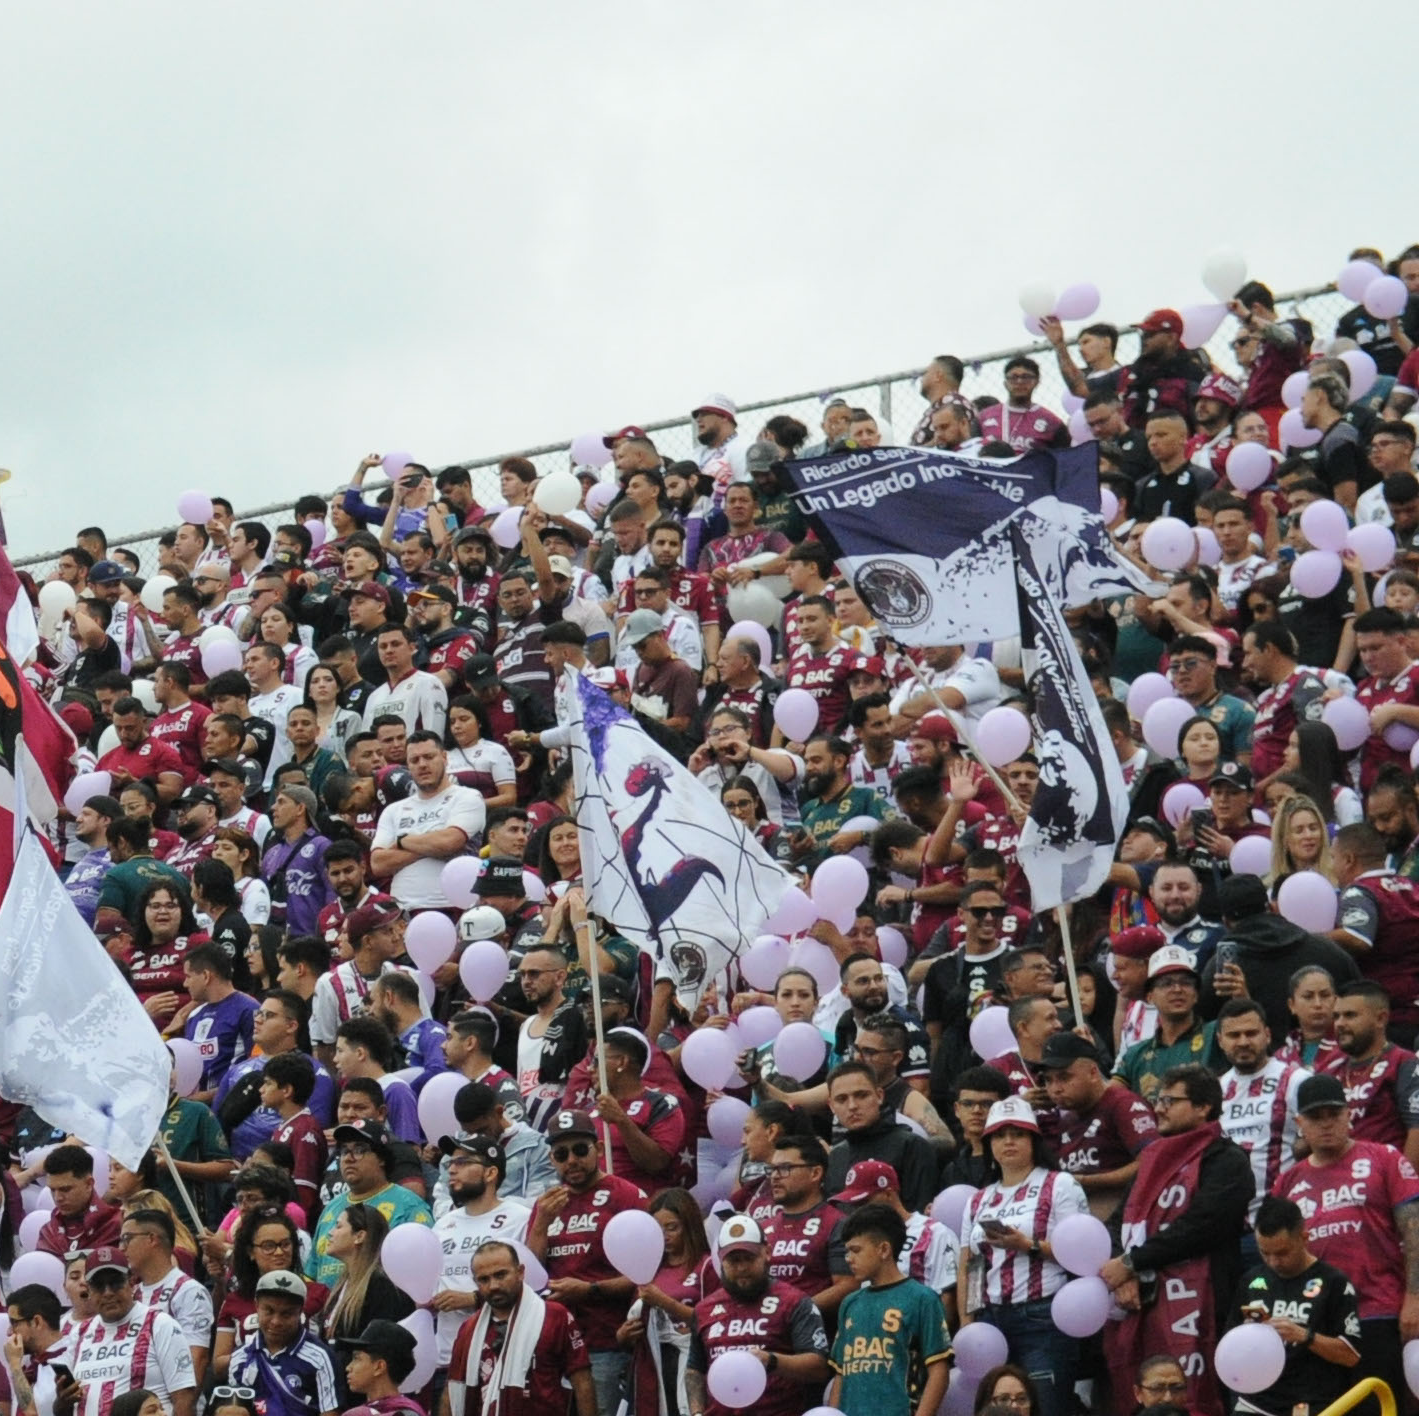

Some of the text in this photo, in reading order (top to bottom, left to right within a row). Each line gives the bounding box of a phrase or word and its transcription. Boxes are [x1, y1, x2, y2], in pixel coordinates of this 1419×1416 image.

[801, 452, 871, 484] Ricardo
[796, 492, 830, 515] Un
[833, 473, 916, 510] Legado
[804, 668, 834, 684] BAC
[503, 699, 514, 713] S
[140, 744, 151, 756] S
[839, 799, 851, 813] S
[813, 819, 840, 832] BAC
[464, 921, 475, 935] T
[1002, 915, 1017, 932] S
[175, 936, 188, 951] S
[1265, 1079, 1277, 1092] S
[168, 1111, 180, 1125] S
[1230, 1102, 1266, 1118] BAC
[559, 1112, 573, 1128] S
[1352, 1159, 1371, 1178] S
[593, 1190, 610, 1207] S
[1027, 1186, 1038, 1199] S
[1322, 1183, 1366, 1204] BAC
[492, 1215, 506, 1229] S
[567, 1213, 599, 1231] BAC
[804, 1218, 820, 1235] S
[774, 1239, 810, 1257] BAC
[770, 1265, 805, 1276] ERTY
[158, 1288, 173, 1303] S
[1304, 1277, 1321, 1298] S
[761, 1297, 779, 1314] S
[1273, 1301, 1311, 1321] BAC
[728, 1318, 767, 1336] BAC
[883, 1309, 902, 1331] S
[128, 1322, 140, 1337] S
[97, 1343, 131, 1361] BAC
[853, 1337, 893, 1359] BAC
